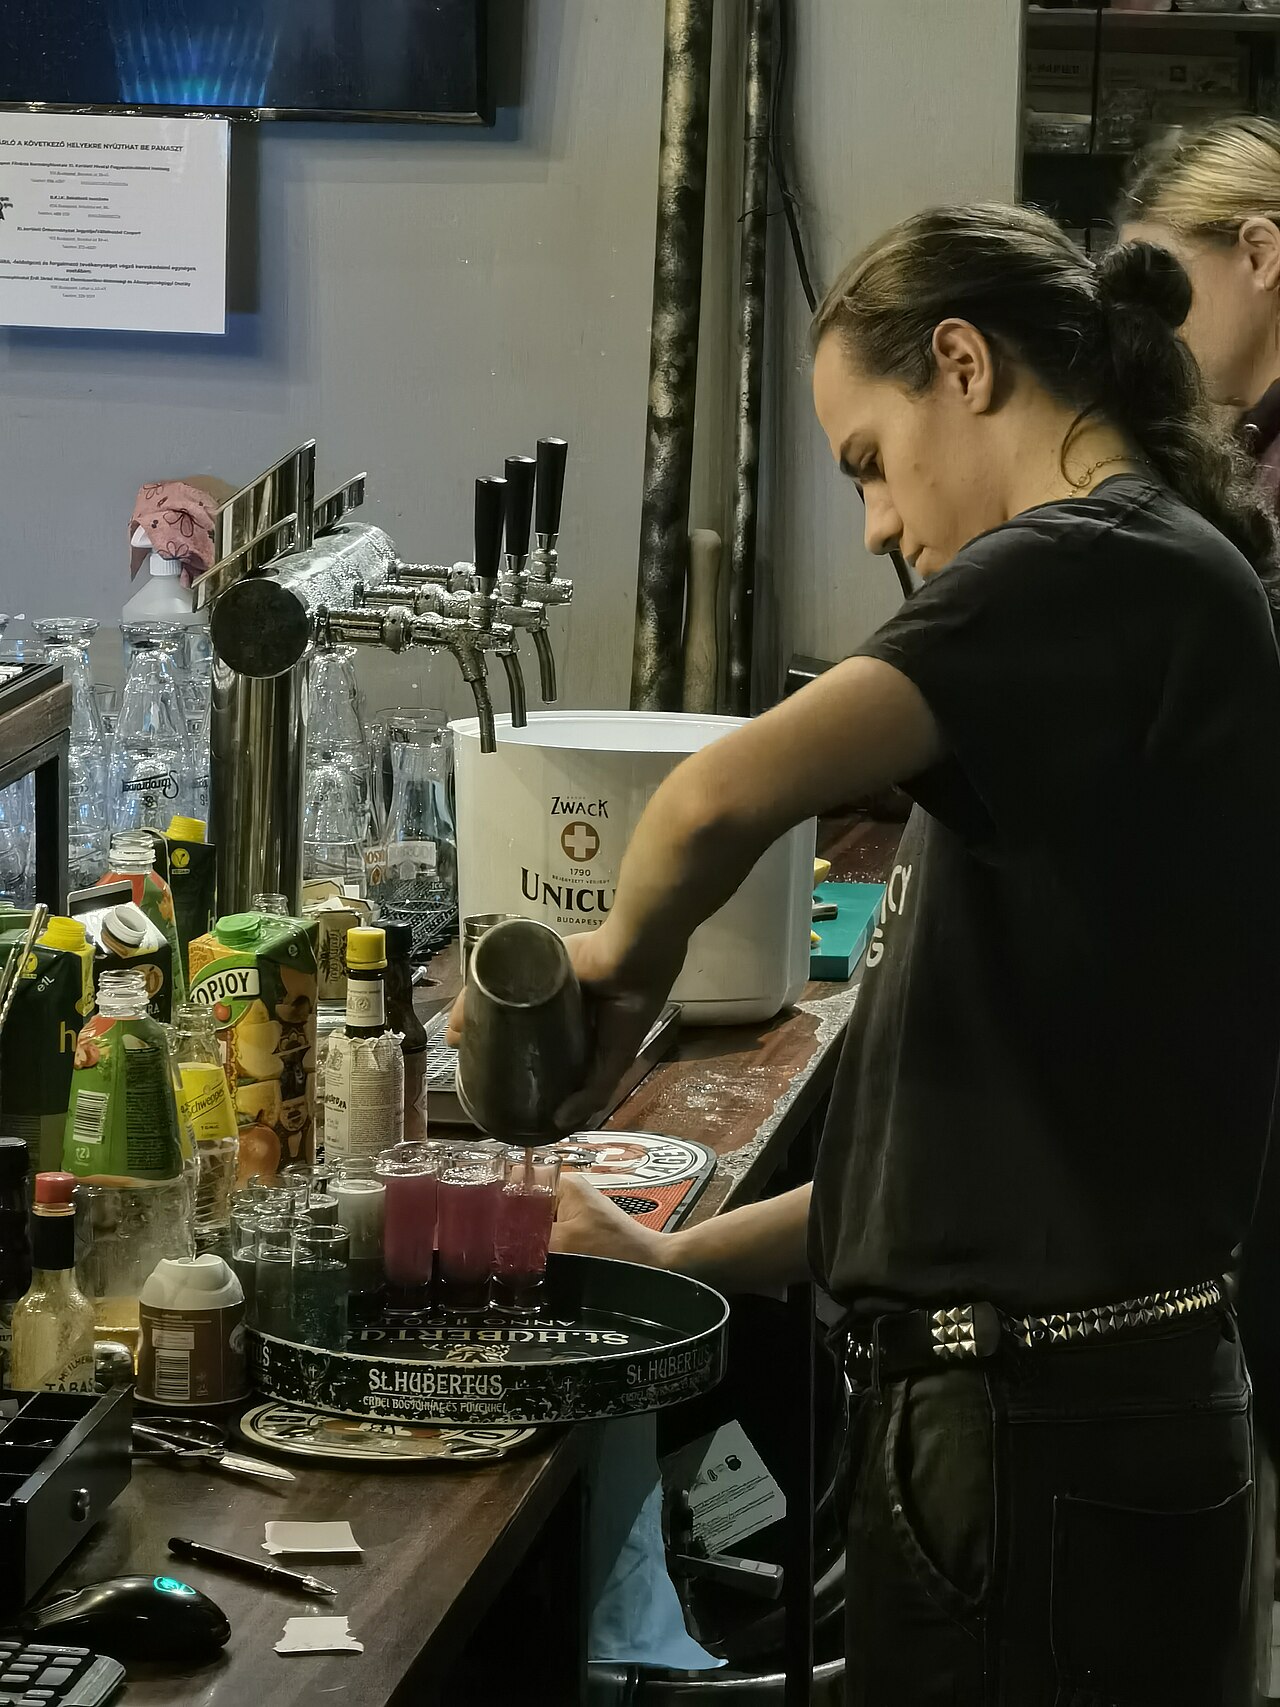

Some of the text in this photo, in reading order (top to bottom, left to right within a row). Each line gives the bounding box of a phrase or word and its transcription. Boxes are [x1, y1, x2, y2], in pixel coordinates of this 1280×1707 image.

[551, 796, 609, 819] ZWACK
[569, 867, 591, 877] 1790
[556, 916, 604, 926] BUDAPEST
